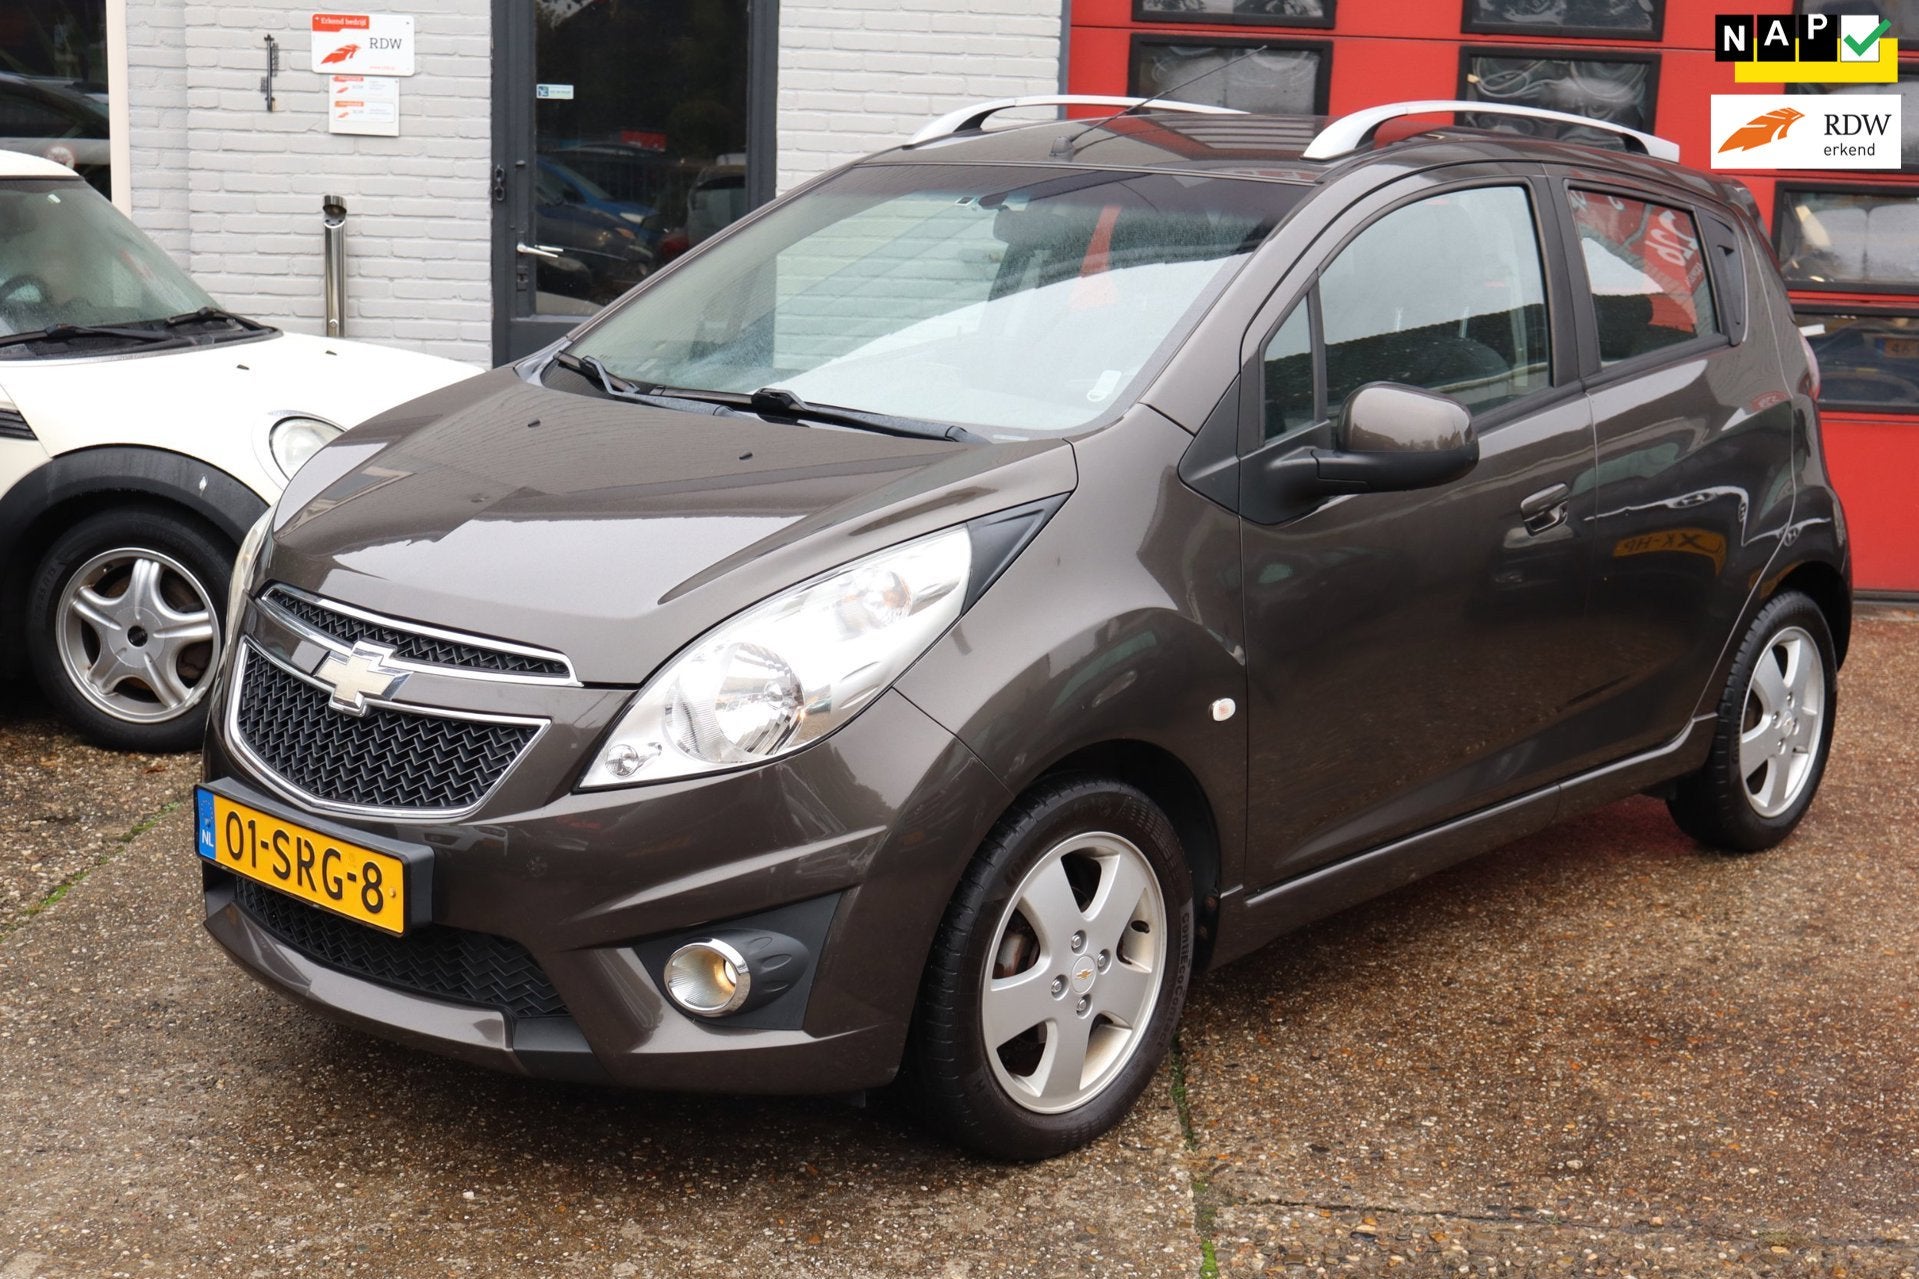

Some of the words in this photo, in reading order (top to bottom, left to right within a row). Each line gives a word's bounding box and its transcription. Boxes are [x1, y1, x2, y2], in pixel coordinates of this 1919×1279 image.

[370, 37, 402, 50] RDW
[201, 831, 214, 848] NL
[225, 811, 384, 914] 01-SRG-8
